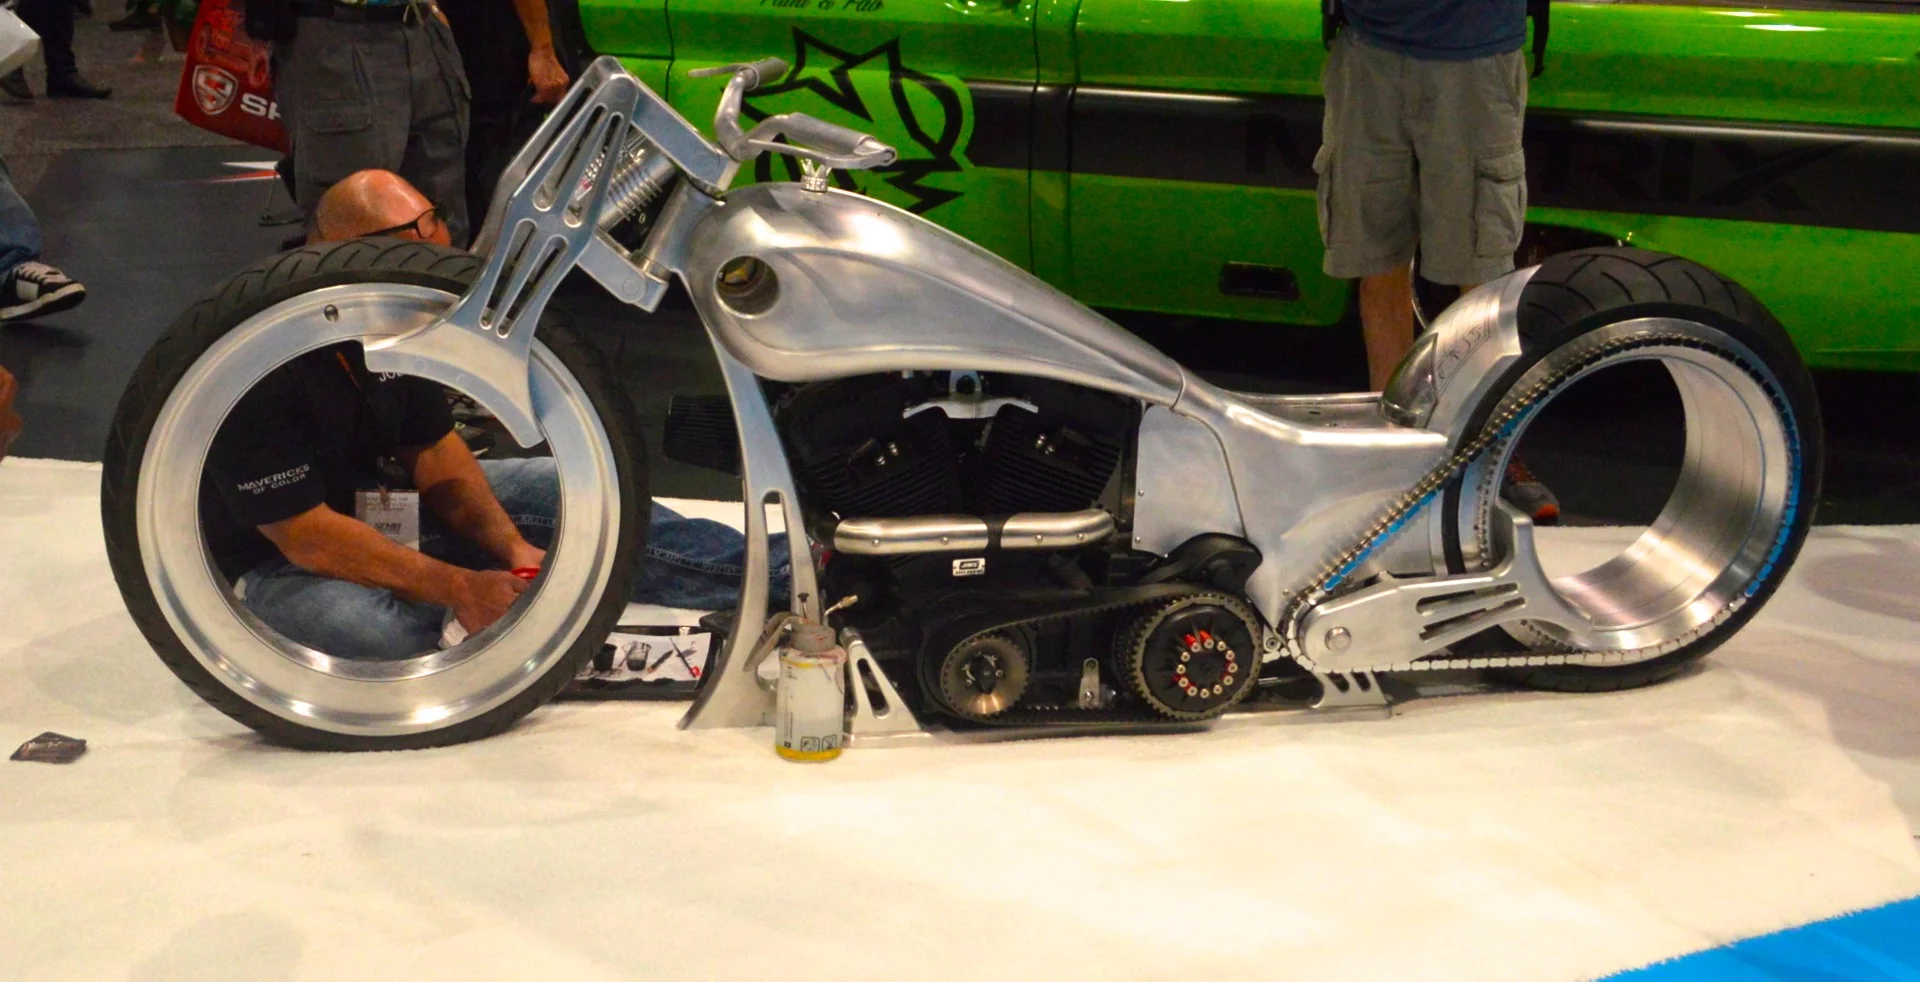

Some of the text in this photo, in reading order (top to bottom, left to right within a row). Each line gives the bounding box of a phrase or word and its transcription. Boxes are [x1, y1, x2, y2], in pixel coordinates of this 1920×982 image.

[237, 463, 310, 492] MAVERICKS
[253, 473, 306, 495] OF COLOR
